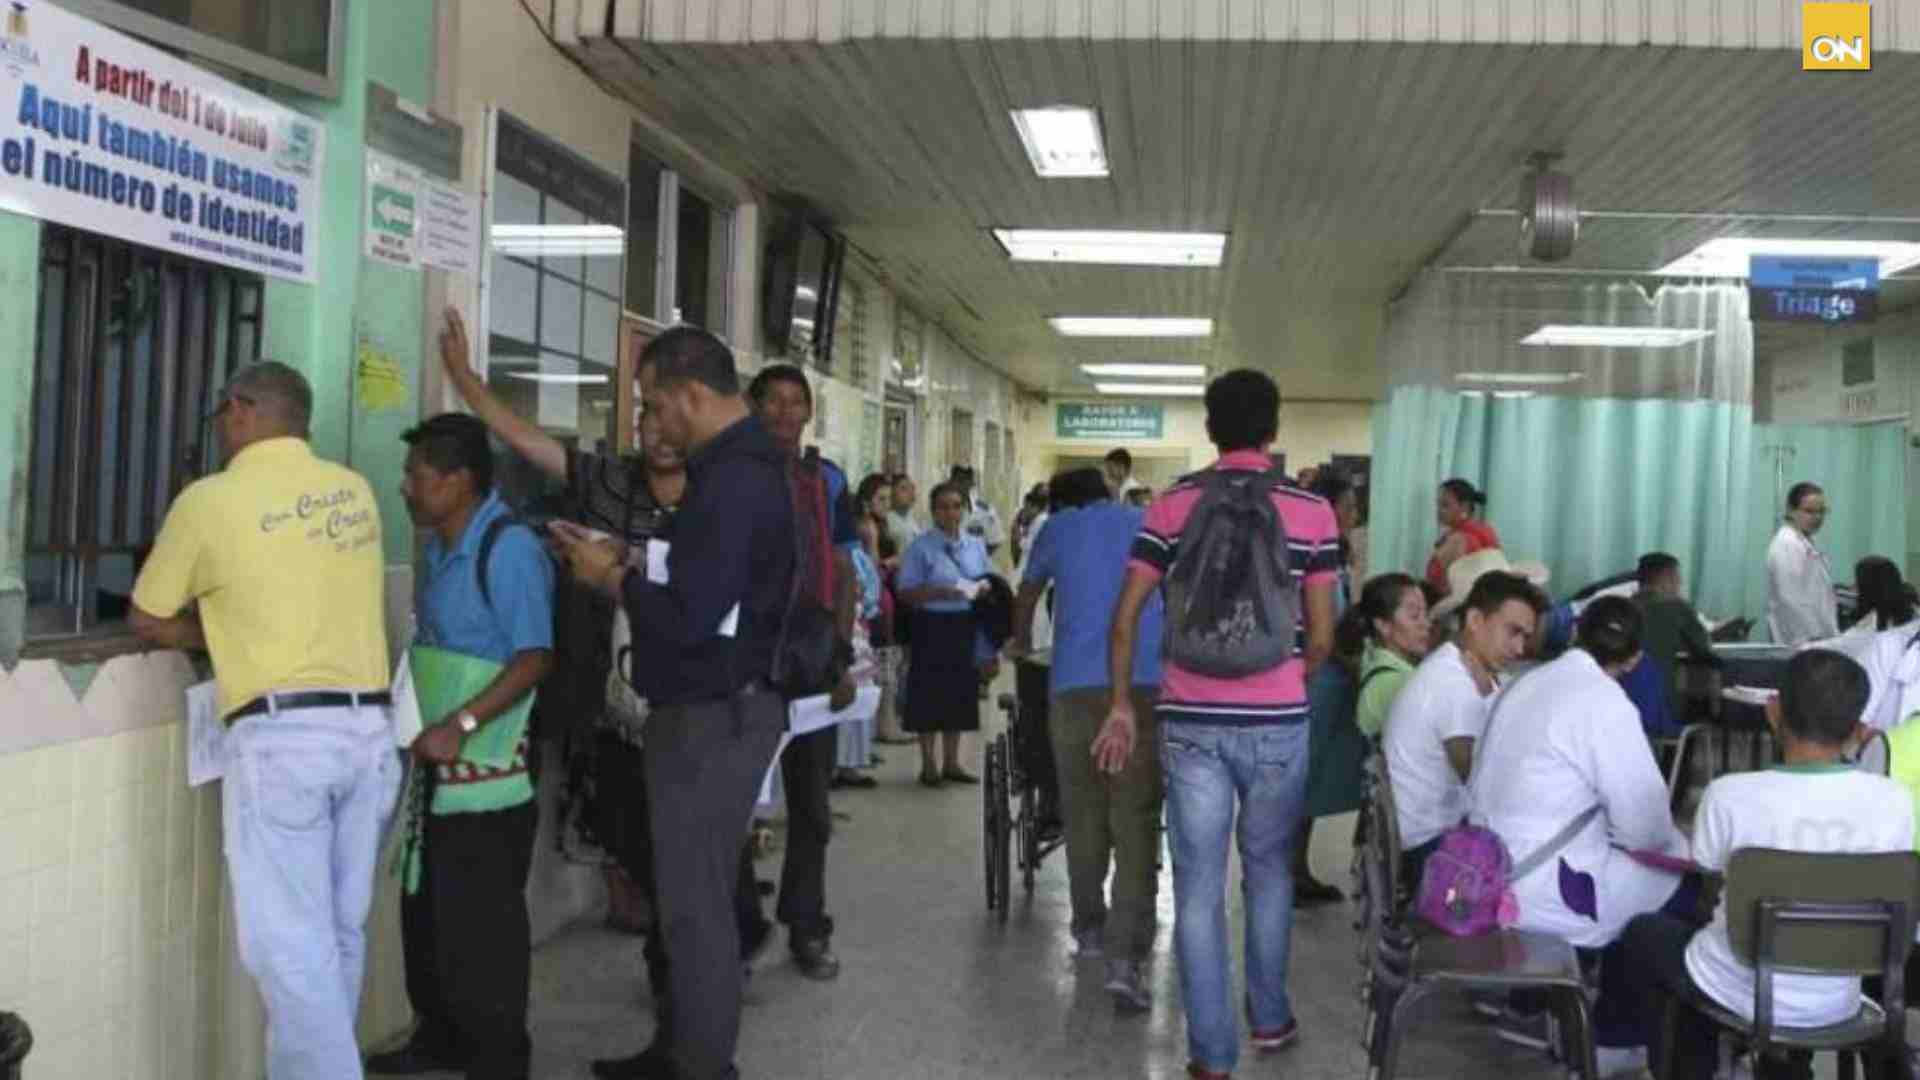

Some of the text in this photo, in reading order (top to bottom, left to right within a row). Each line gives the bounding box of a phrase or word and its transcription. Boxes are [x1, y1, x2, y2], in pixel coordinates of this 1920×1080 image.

[76, 45, 89, 83] A
[95, 57, 154, 108] partir
[159, 80, 188, 121] del
[204, 99, 226, 136] de
[18, 83, 92, 145] Aquí
[98, 113, 207, 183] también
[212, 157, 297, 212] usamos
[1, 138, 35, 179] el
[43, 150, 155, 213] número
[162, 183, 193, 223] de
[199, 193, 303, 254] identidad
[1773, 291, 1855, 320] Triage
[1063, 416, 1156, 428] LABORATORIO
